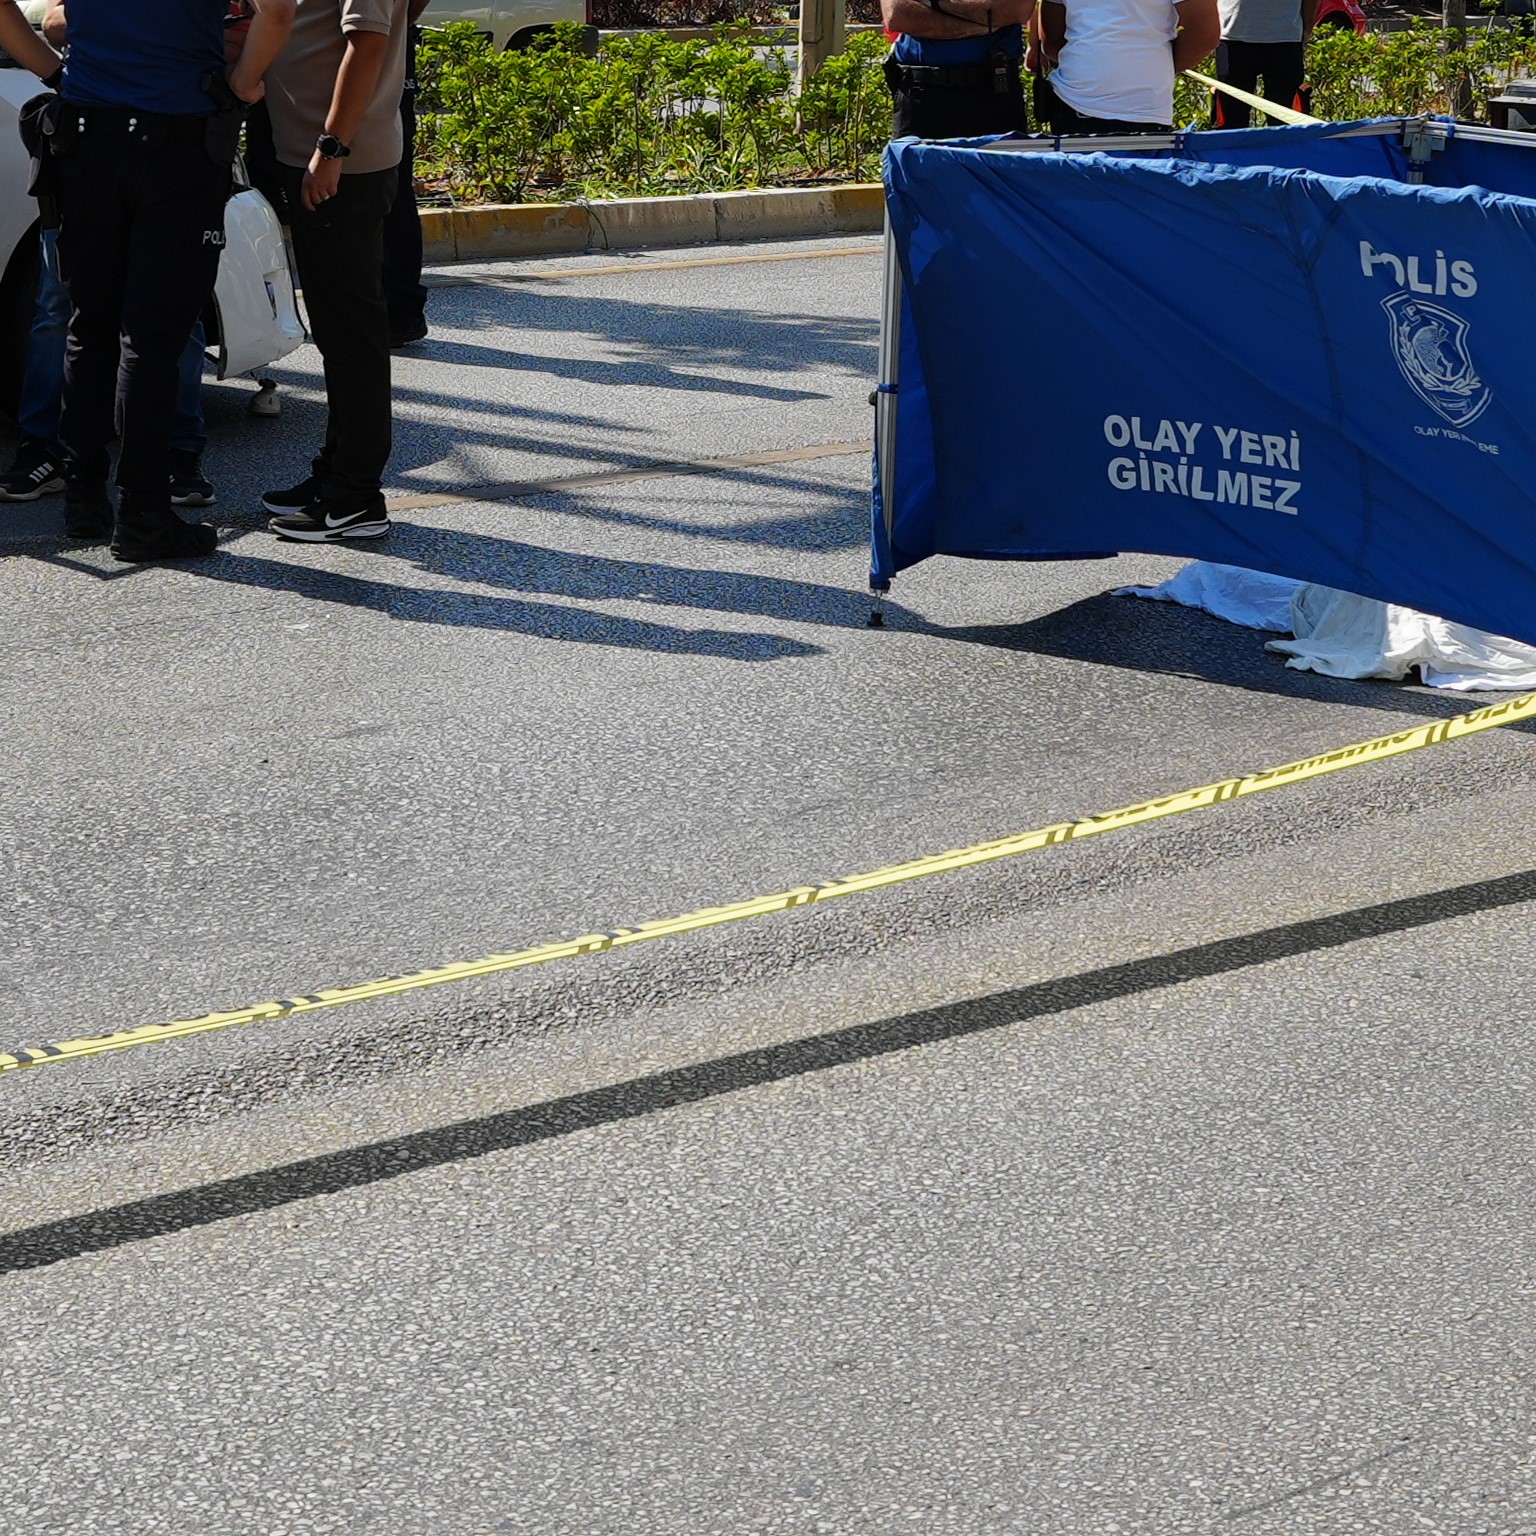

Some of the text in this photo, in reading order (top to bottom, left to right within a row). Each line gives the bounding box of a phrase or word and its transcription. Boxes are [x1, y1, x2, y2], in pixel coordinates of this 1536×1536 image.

[1104, 414, 1300, 471] OLAY YERİ
[1107, 451, 1301, 515] GİRİLMEZ
